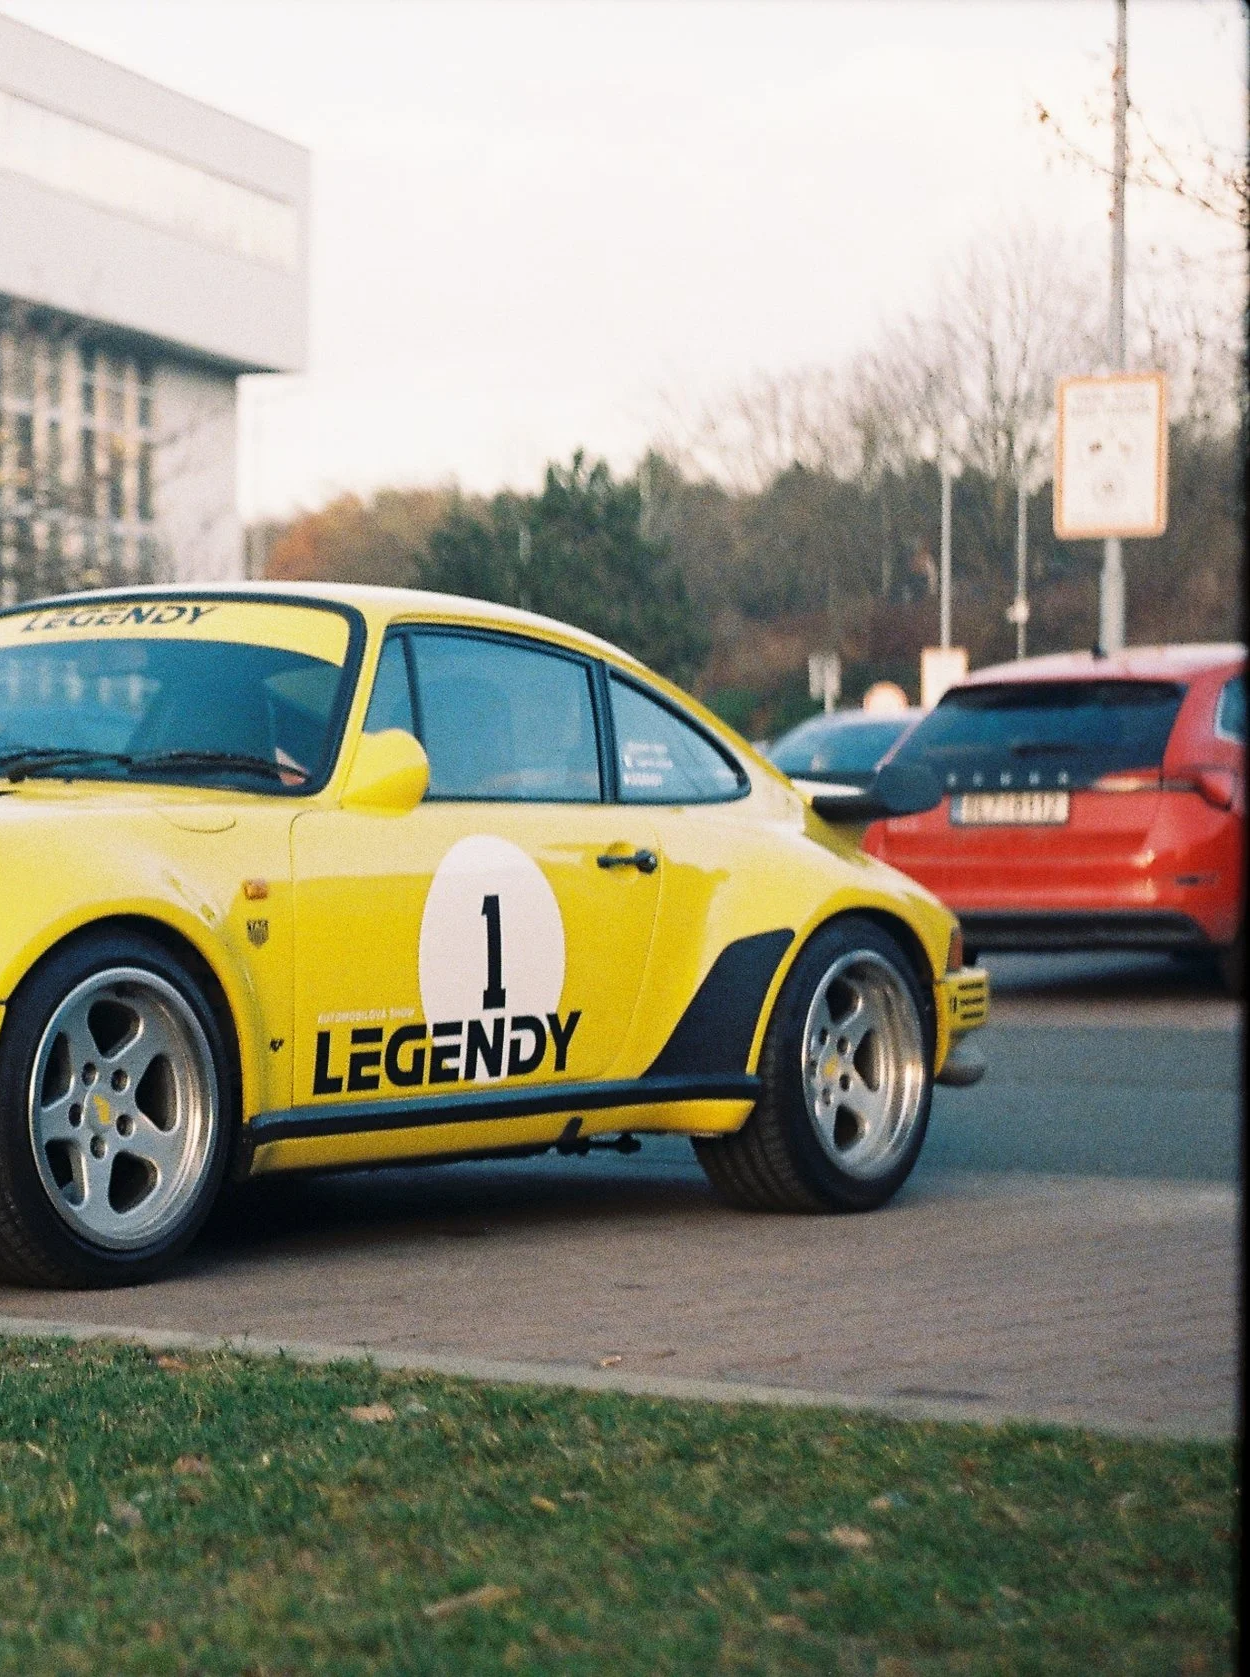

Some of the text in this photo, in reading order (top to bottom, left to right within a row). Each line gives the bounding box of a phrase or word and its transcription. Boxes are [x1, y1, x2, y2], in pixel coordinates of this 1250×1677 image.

[21, 605, 217, 631] LEGENDY
[481, 894, 506, 1009] 1
[313, 1011, 582, 1095] LEGENDY
